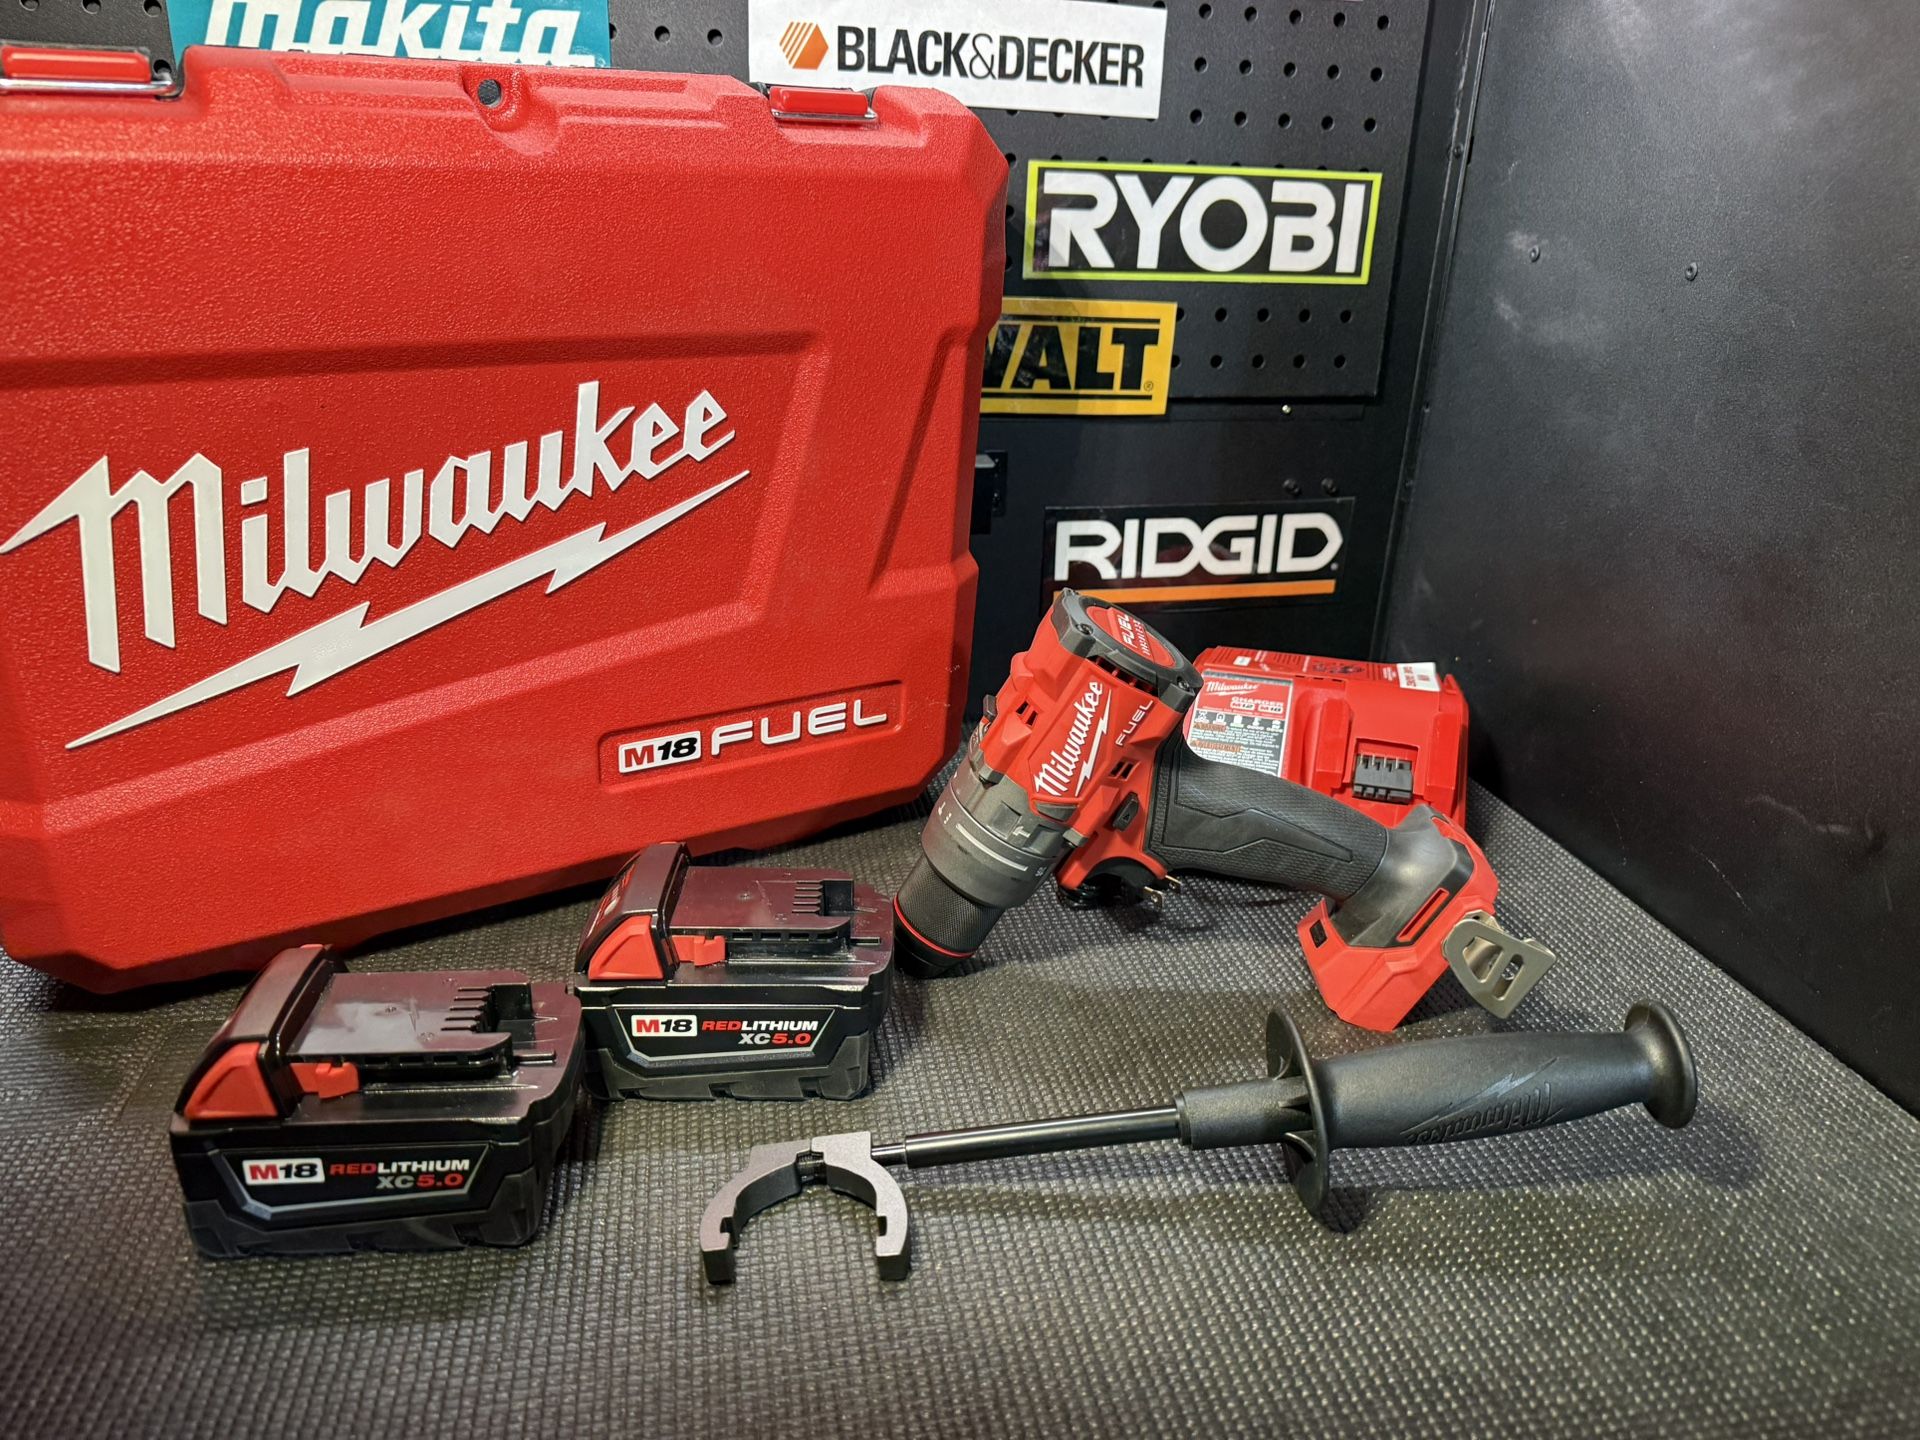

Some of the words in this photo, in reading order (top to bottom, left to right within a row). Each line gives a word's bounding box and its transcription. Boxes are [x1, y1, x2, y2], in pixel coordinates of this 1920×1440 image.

[837, 25, 1144, 88] BLACK&DECKER
[1043, 168, 1367, 274] RYOBI
[0, 380, 736, 674] Milwaukee
[1054, 512, 1344, 582] RIDGID
[622, 734, 699, 769] M18
[711, 698, 888, 757] FUEL
[1033, 681, 1104, 797] Milwaukee
[1115, 699, 1153, 747] FUEL
[635, 1017, 694, 1034] M18
[701, 1019, 818, 1032] REDLITHIUM
[738, 1032, 812, 1045] XC5.0
[248, 1161, 320, 1181] M18
[330, 1159, 470, 1177] REDLITHIUM
[376, 1173, 465, 1189] XC5.0
